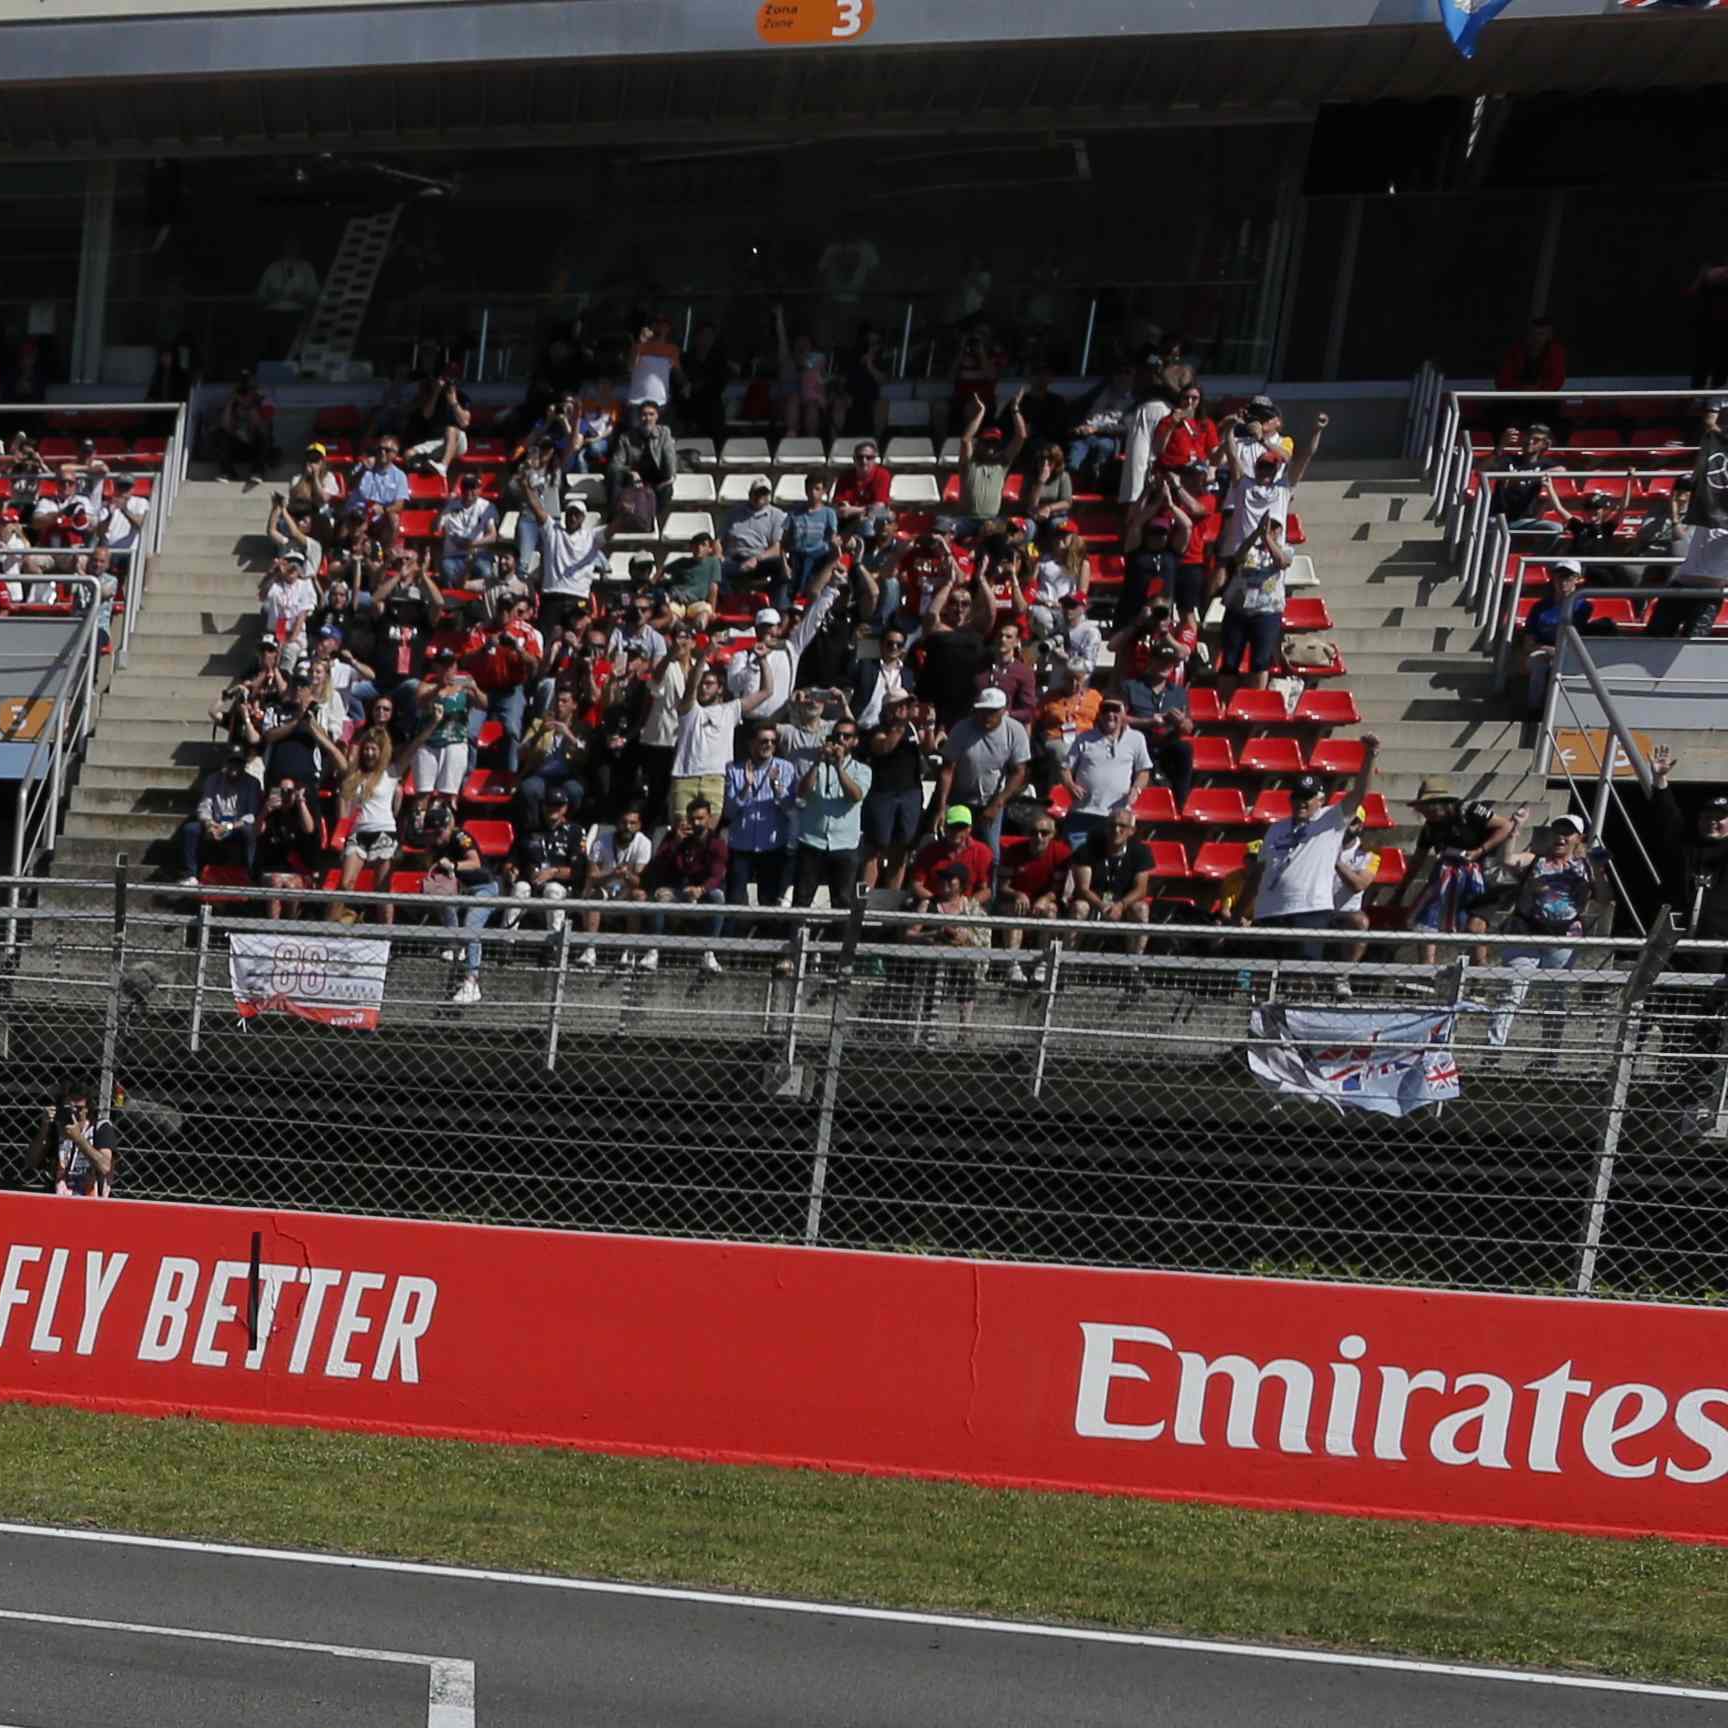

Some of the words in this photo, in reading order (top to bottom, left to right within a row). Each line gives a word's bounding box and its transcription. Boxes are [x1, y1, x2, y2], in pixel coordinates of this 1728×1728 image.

[831, 0, 863, 37] 3
[272, 943, 329, 996] 88
[137, 1256, 439, 1384] BETTER
[1074, 1321, 1728, 1484] Emirates
